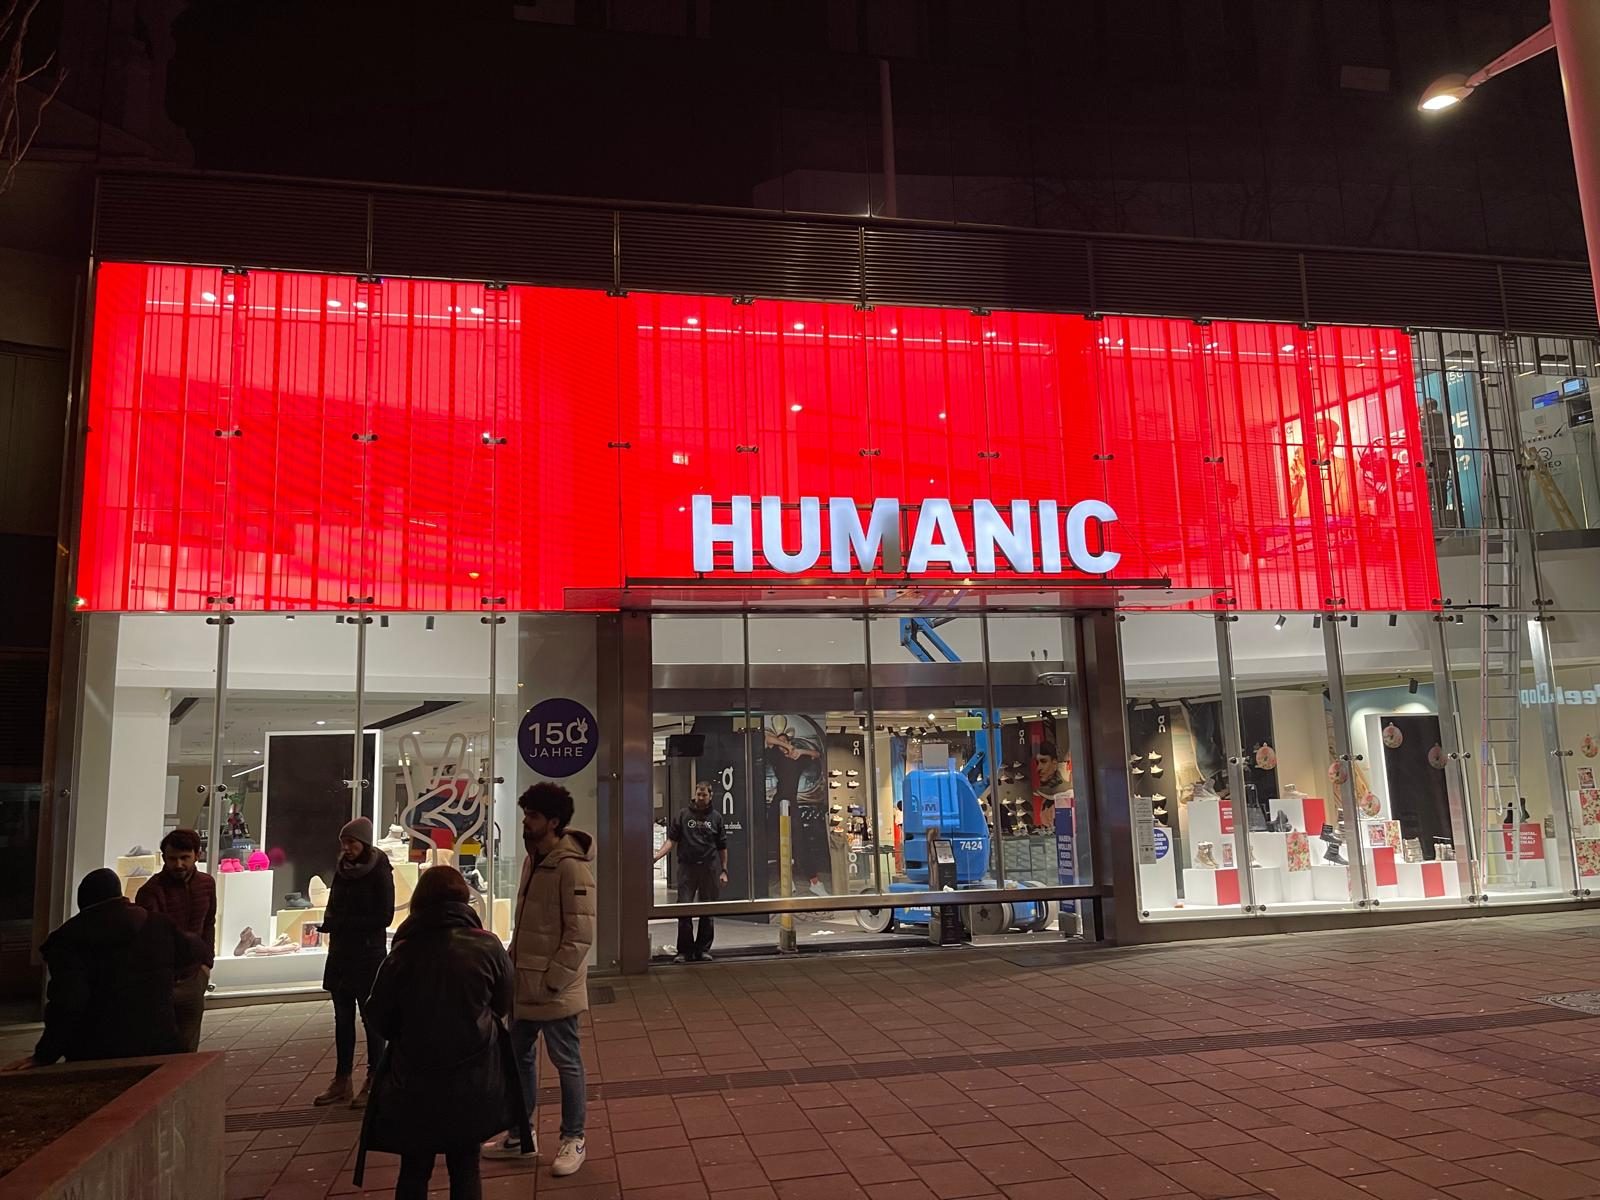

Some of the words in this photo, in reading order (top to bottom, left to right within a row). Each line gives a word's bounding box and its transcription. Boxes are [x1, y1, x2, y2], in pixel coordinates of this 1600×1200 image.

[692, 495, 1121, 573] HUMANIC
[528, 717, 588, 745] 150
[529, 746, 583, 758] JAHRE
[960, 841, 983, 851] 7424
